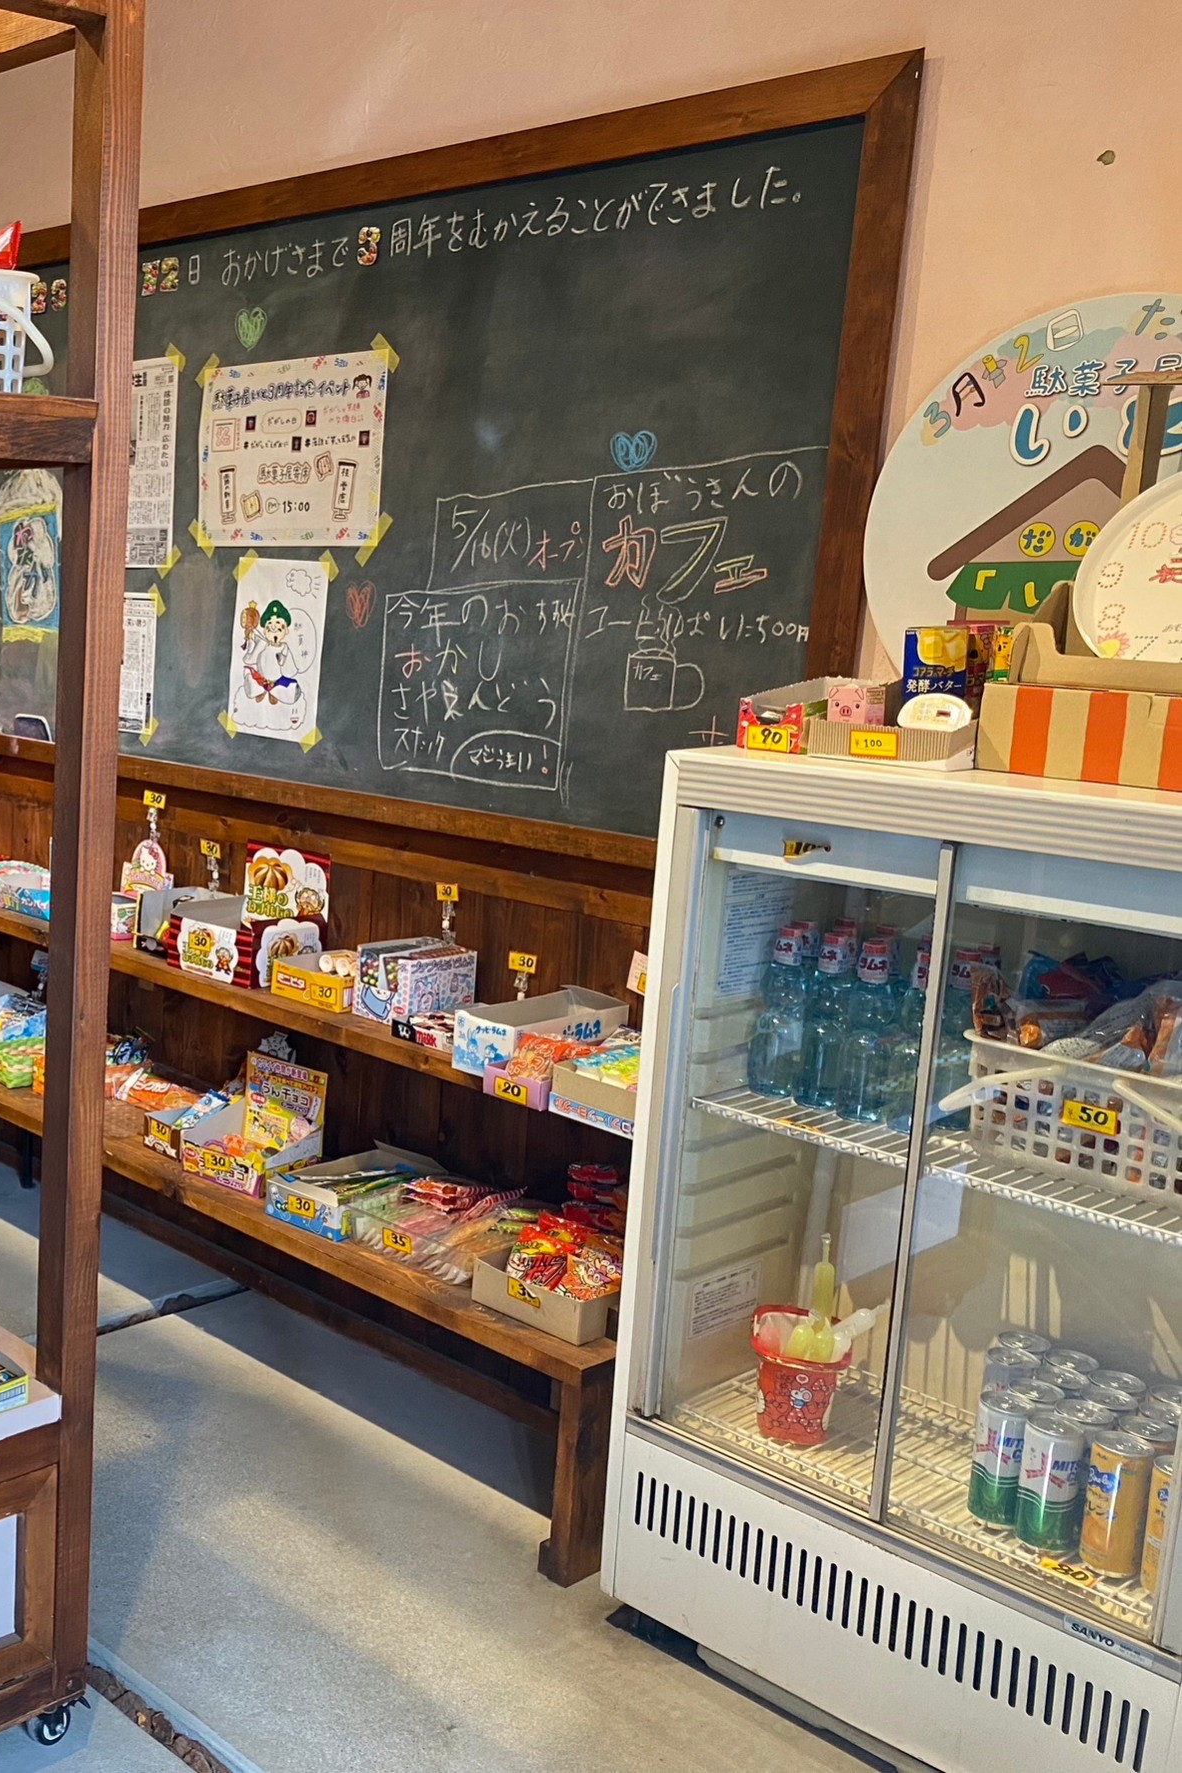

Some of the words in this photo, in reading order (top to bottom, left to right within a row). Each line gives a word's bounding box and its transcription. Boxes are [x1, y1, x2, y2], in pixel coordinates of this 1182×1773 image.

[283, 500, 310, 513] 15:00
[602, 514, 768, 604] カフェ
[395, 638, 502, 681] おかし
[905, 678, 963, 693] 発酵バター
[760, 728, 784, 745] 90
[864, 739, 883, 748] 100
[150, 793, 163, 804] 30
[441, 885, 452, 896] 30
[194, 935, 208, 947] 30
[860, 956, 888, 971] ラムネ
[318, 986, 332, 998] 30
[262, 1082, 309, 1106] うんチョコ
[501, 1081, 522, 1097] 20
[1078, 1105, 1109, 1126] 50
[210, 1154, 226, 1167] 30
[294, 1198, 311, 1212] 30
[392, 1233, 407, 1248] 35
[1071, 1622, 1115, 1647] SANYO
